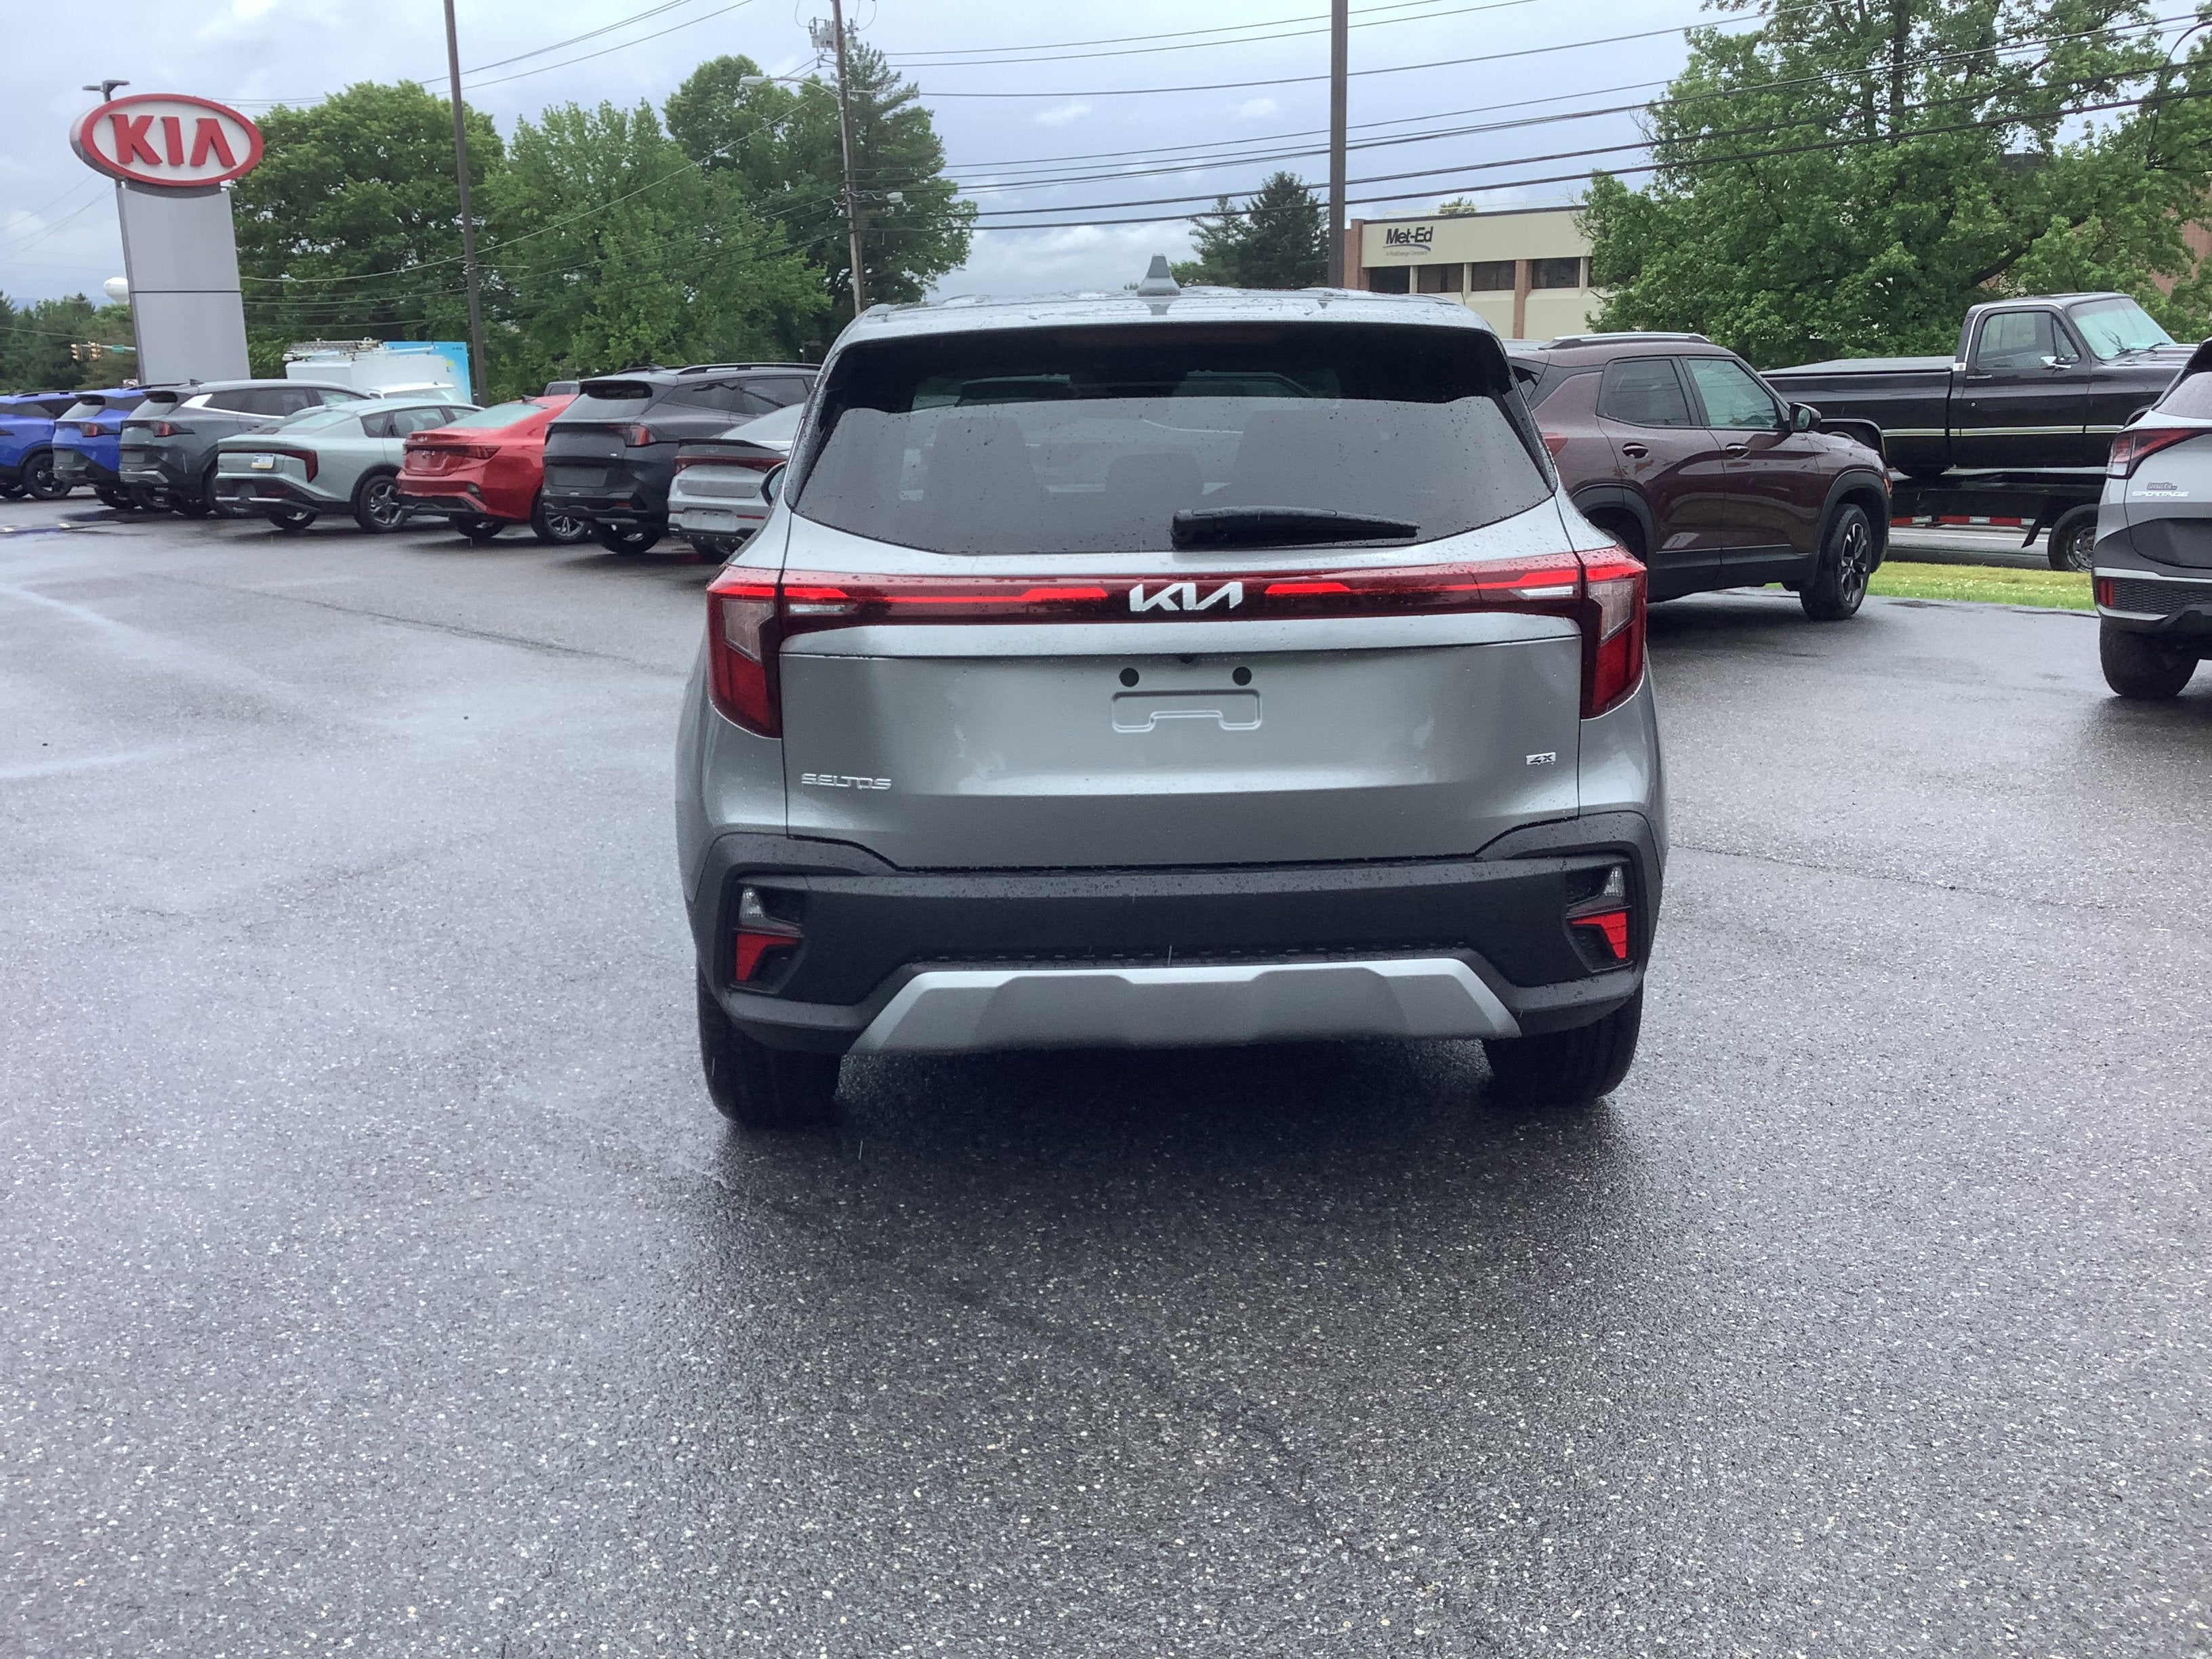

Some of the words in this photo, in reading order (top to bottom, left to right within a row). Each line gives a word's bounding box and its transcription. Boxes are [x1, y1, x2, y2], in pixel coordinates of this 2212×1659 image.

[109, 114, 237, 168] KIA
[1386, 226, 1433, 244] Met-Ed
[1129, 581, 1243, 611] KIA
[801, 773, 892, 790] SELTOS
